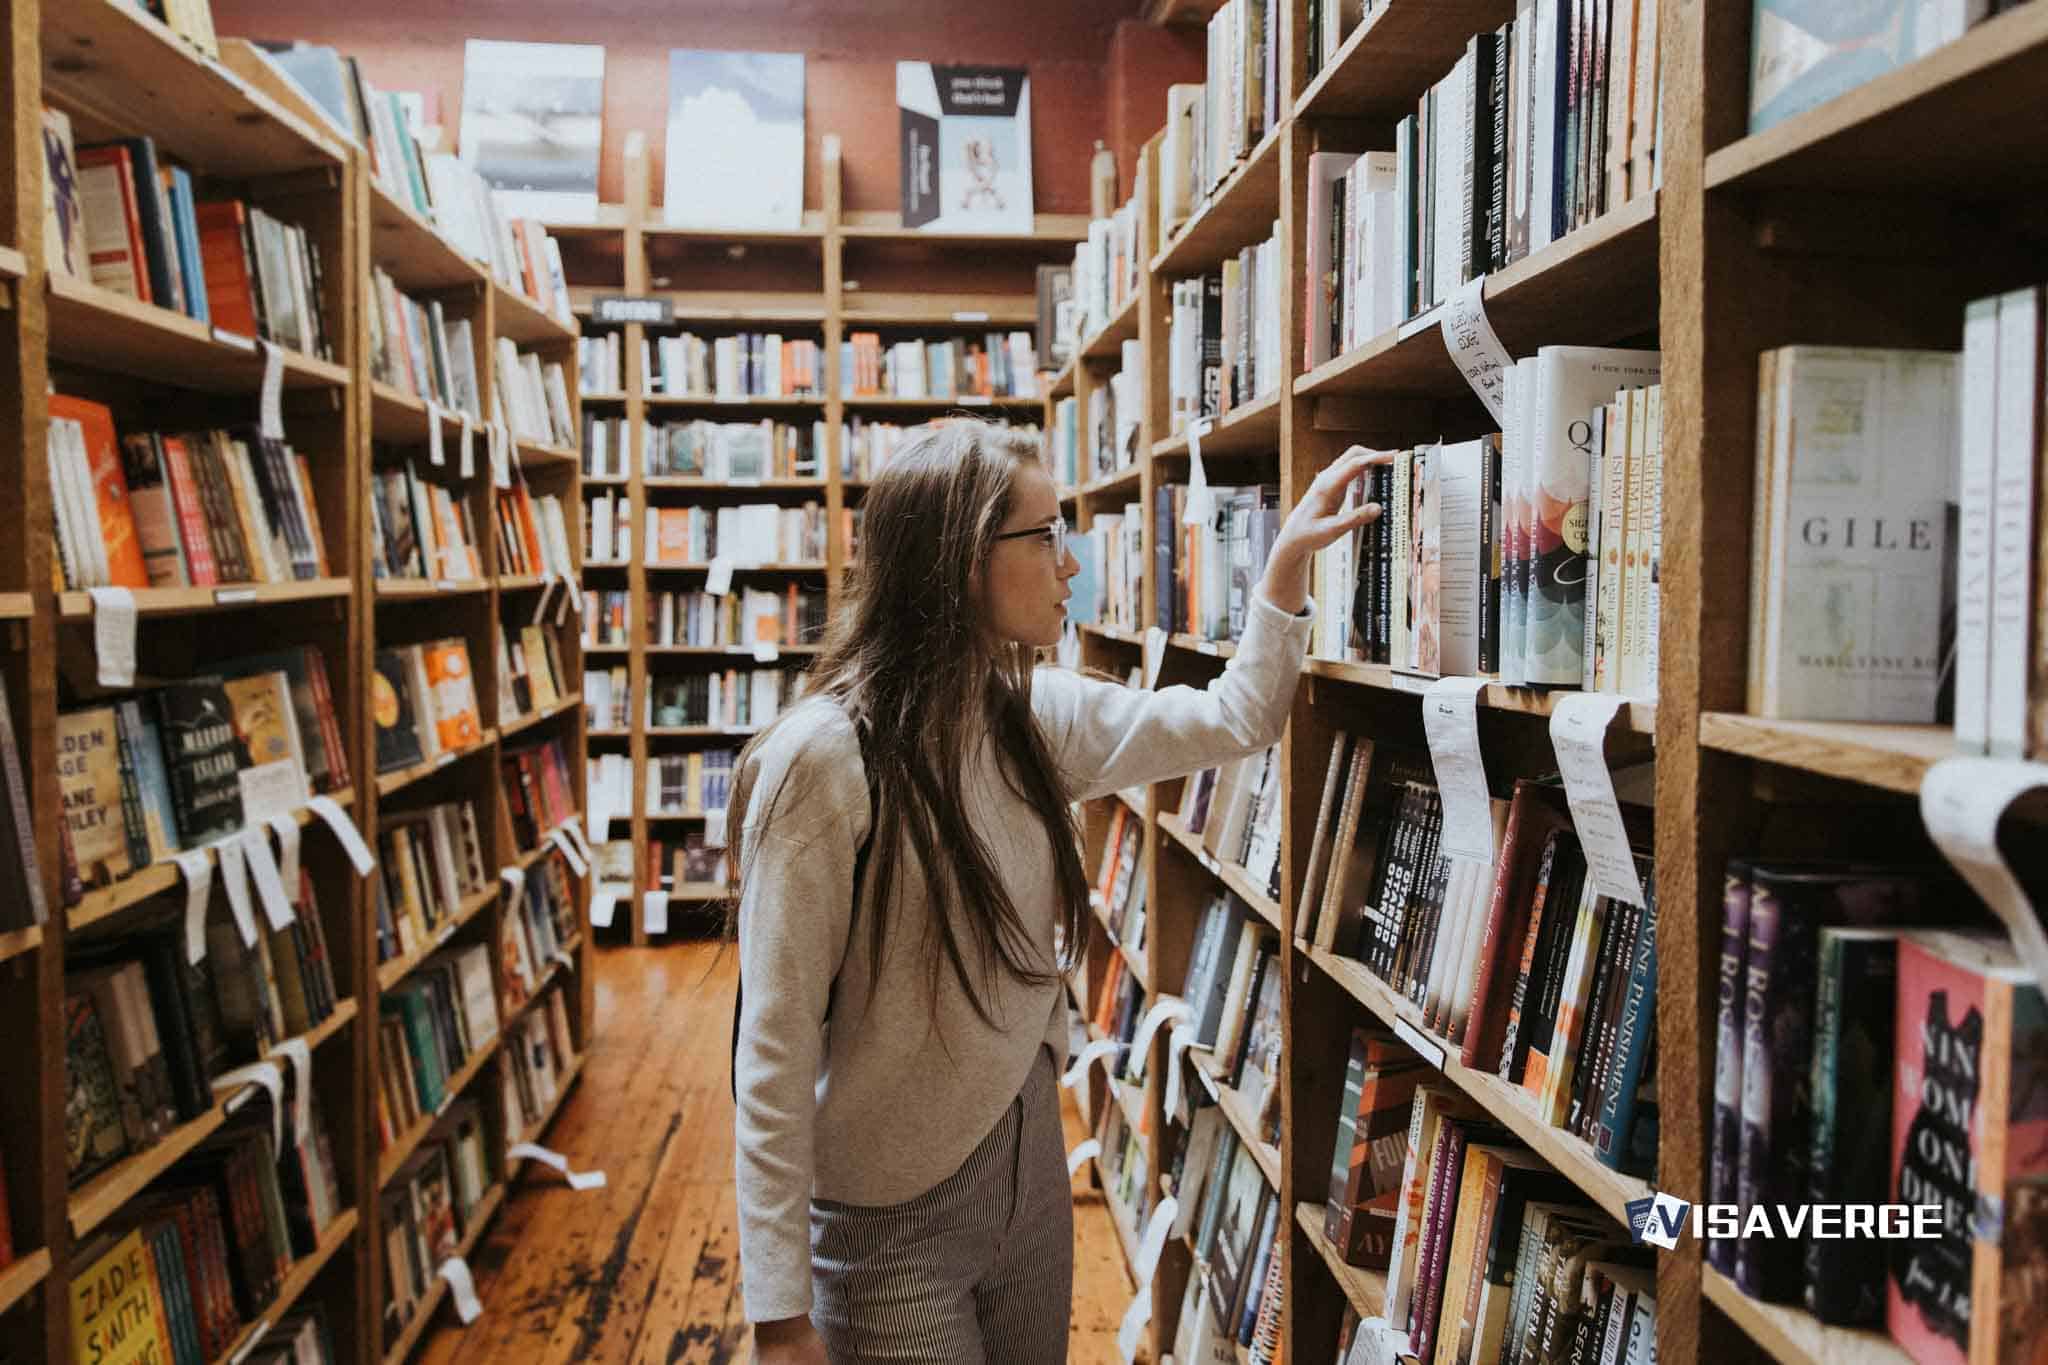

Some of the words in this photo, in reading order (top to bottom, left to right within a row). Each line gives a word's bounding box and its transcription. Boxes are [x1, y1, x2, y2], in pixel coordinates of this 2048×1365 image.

[1494, 38, 1506, 93] THOMAS
[1493, 94, 1505, 155] PYNCHON
[1491, 162, 1504, 224] BLEEDING
[1490, 228, 1502, 261] EDGE
[1608, 456, 1623, 529] ISHMAEL
[1626, 456, 1641, 533] ISHMAEL
[1382, 865, 1403, 944] OTARED
[1390, 870, 1411, 949] OTARED
[1719, 953, 1739, 1028] ROSE
[1743, 965, 1769, 1052] ROSE
[1606, 983, 1645, 1119] PUNISHMENT
[1373, 1130, 1410, 1172] FOU
[79, 1247, 143, 1324] ZADIE
[1429, 1234, 1442, 1279] WOMAN
[87, 1287, 151, 1365] SMITH
[1527, 1281, 1545, 1337] RISEN
[1541, 1296, 1559, 1353] RISEN
[1613, 1295, 1625, 1314] THE
[1604, 1319, 1619, 1362] WORLD
